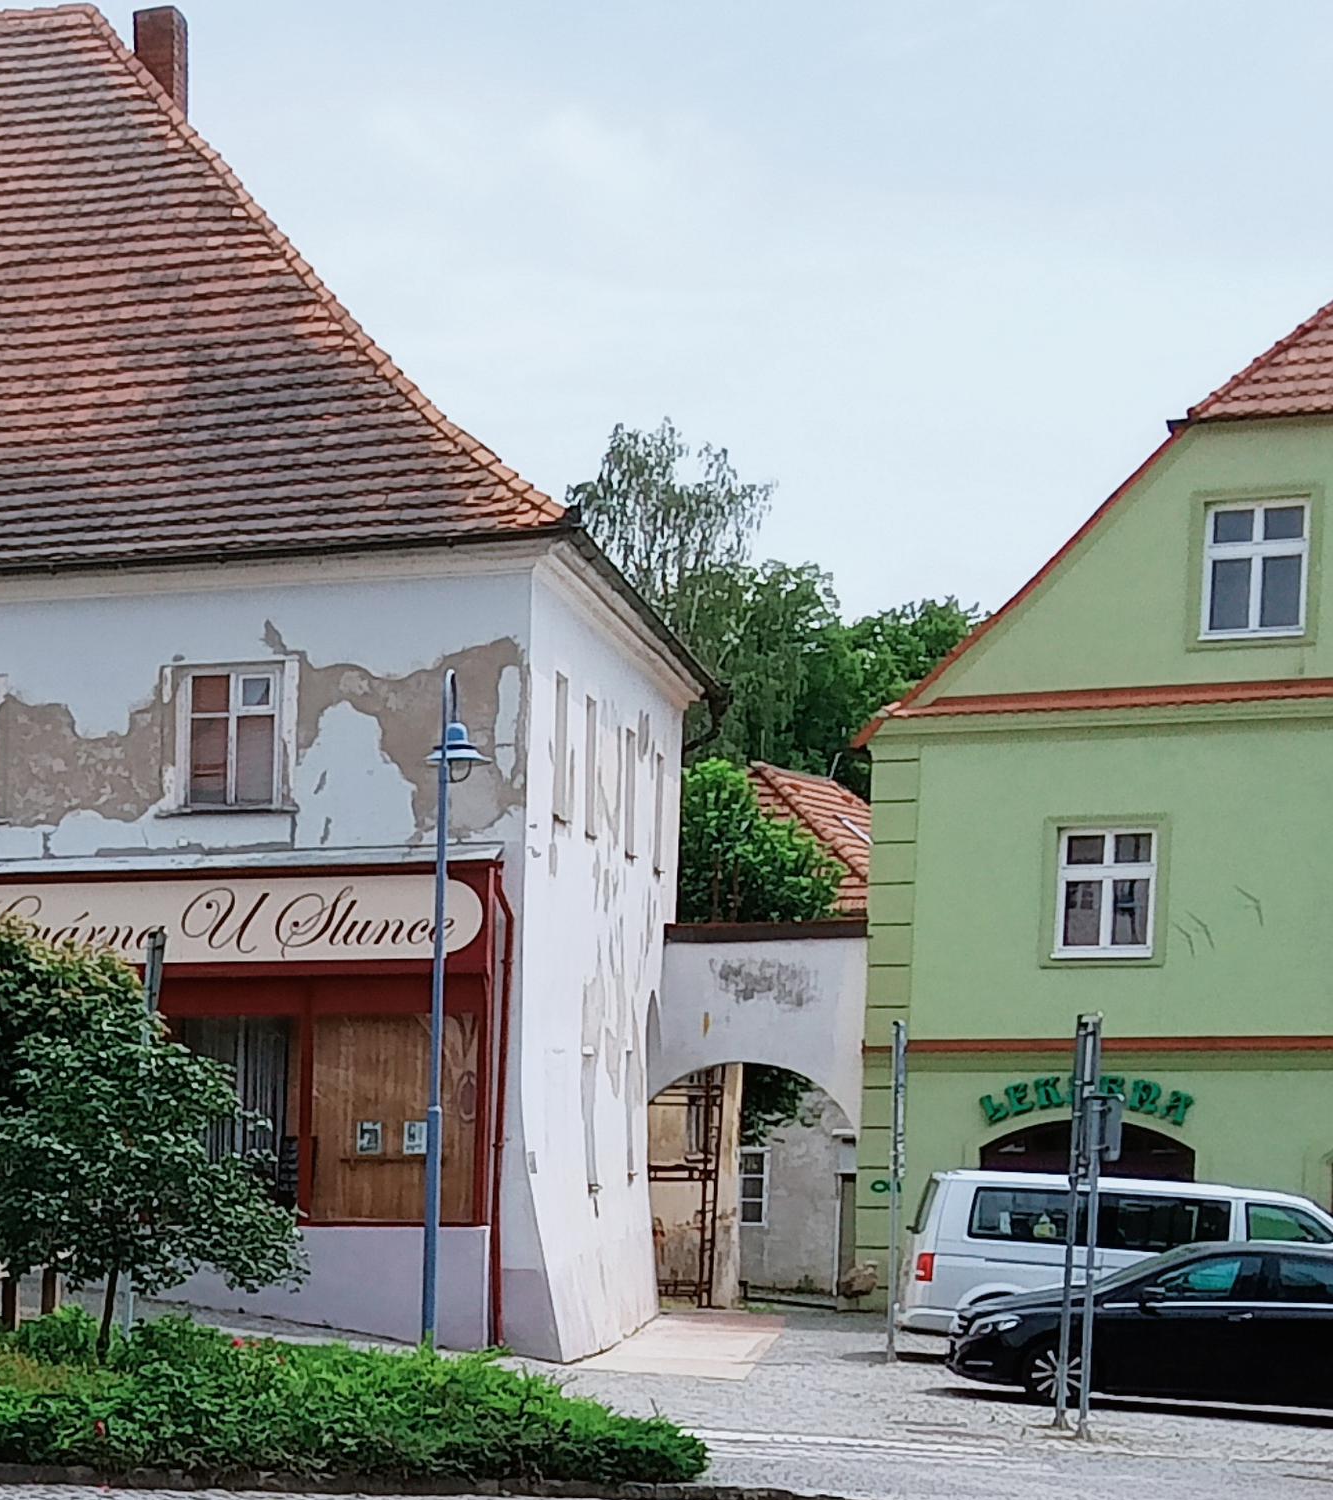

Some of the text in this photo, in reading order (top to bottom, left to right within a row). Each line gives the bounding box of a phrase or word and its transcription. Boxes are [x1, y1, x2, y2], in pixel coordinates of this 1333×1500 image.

[181, 886, 258, 953] U
[274, 885, 455, 959] Slunce
[979, 1074, 1195, 1127] LEKRNA
